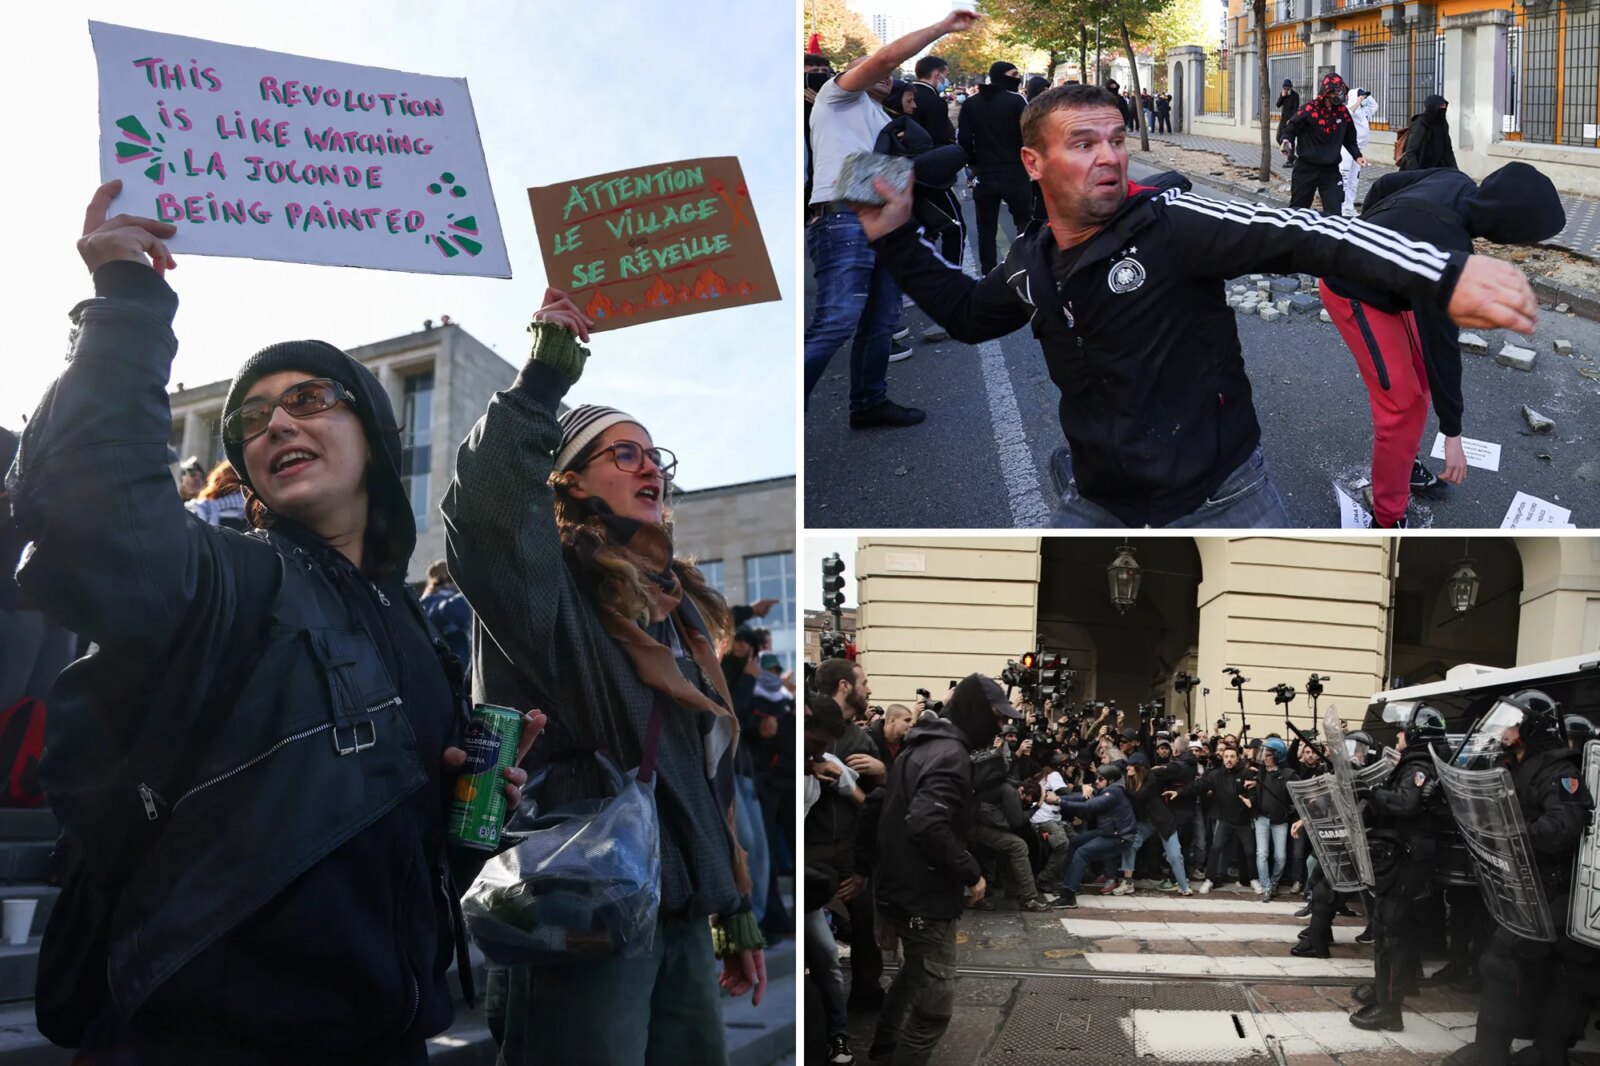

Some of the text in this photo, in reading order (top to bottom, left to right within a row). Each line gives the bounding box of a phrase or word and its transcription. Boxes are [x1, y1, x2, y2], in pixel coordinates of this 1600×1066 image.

[184, 148, 383, 189] LA JOCONDE
[553, 224, 583, 256] LE
[571, 259, 606, 288] SE
